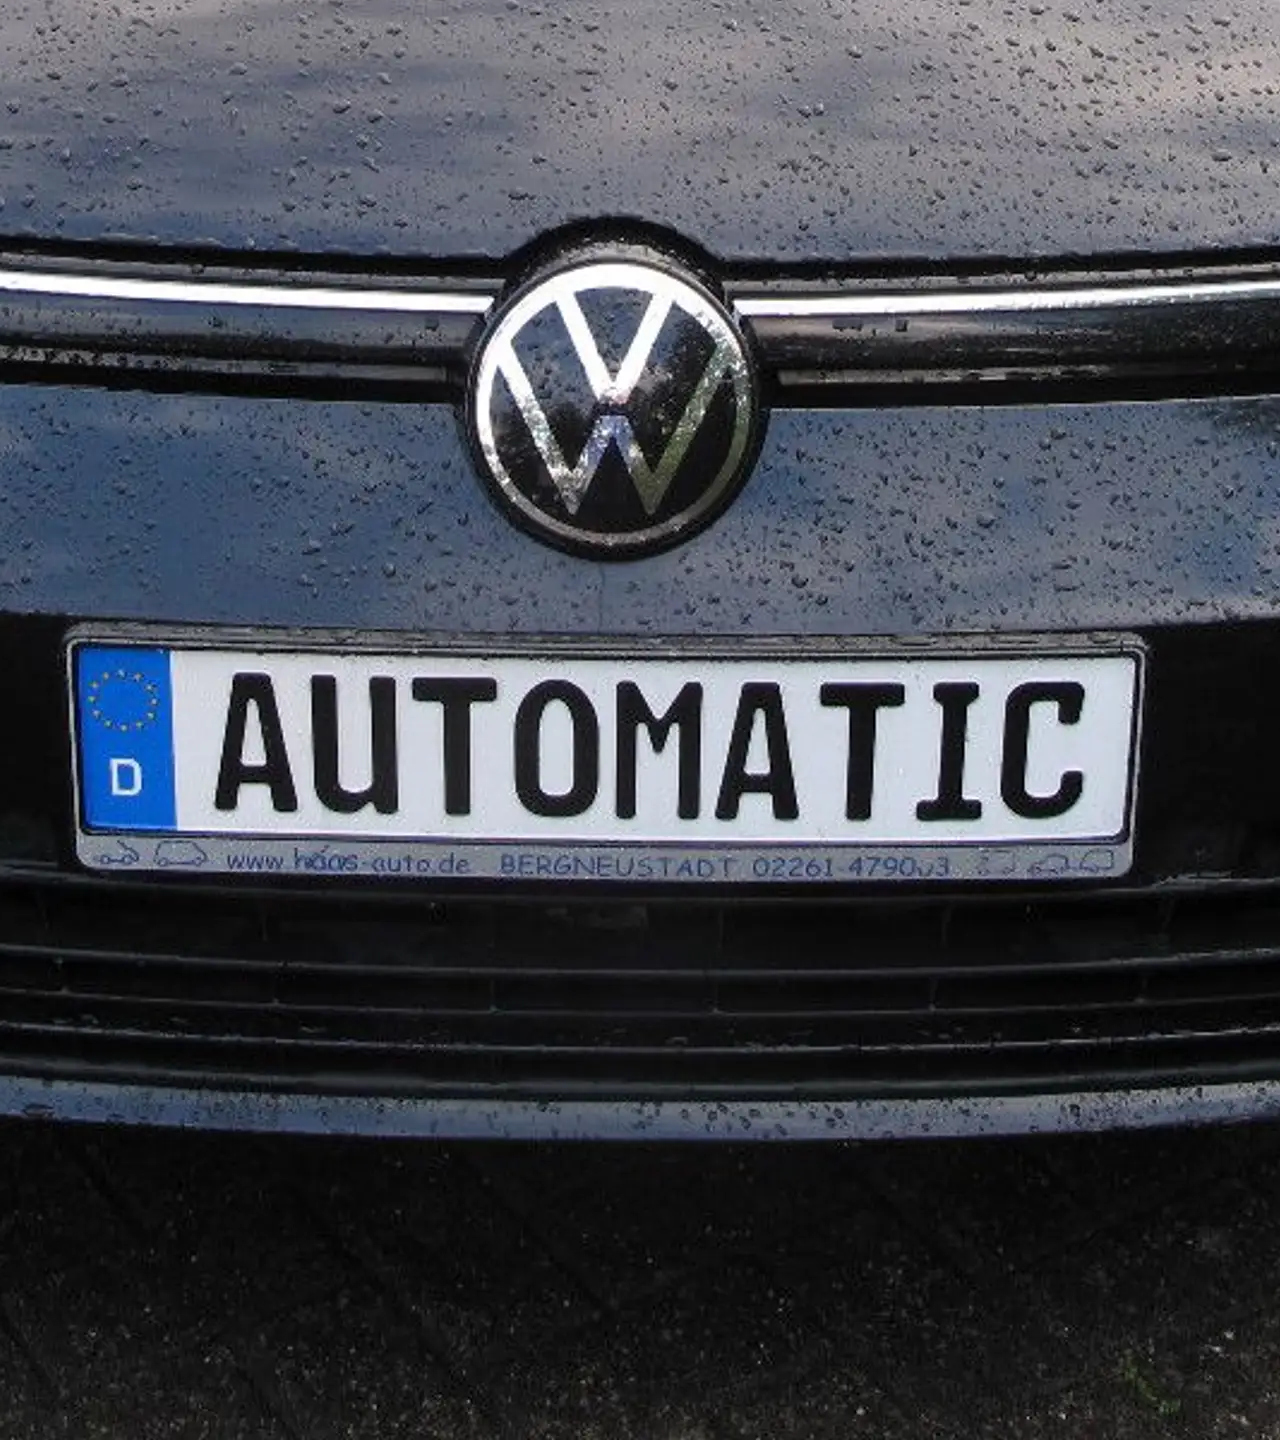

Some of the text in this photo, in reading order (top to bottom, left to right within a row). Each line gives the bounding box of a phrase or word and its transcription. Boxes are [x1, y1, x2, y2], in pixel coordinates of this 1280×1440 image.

[215, 671, 1086, 822] AUTOMATIC
[108, 758, 143, 797] D
[499, 853, 735, 878] BERGNEUSTADT
